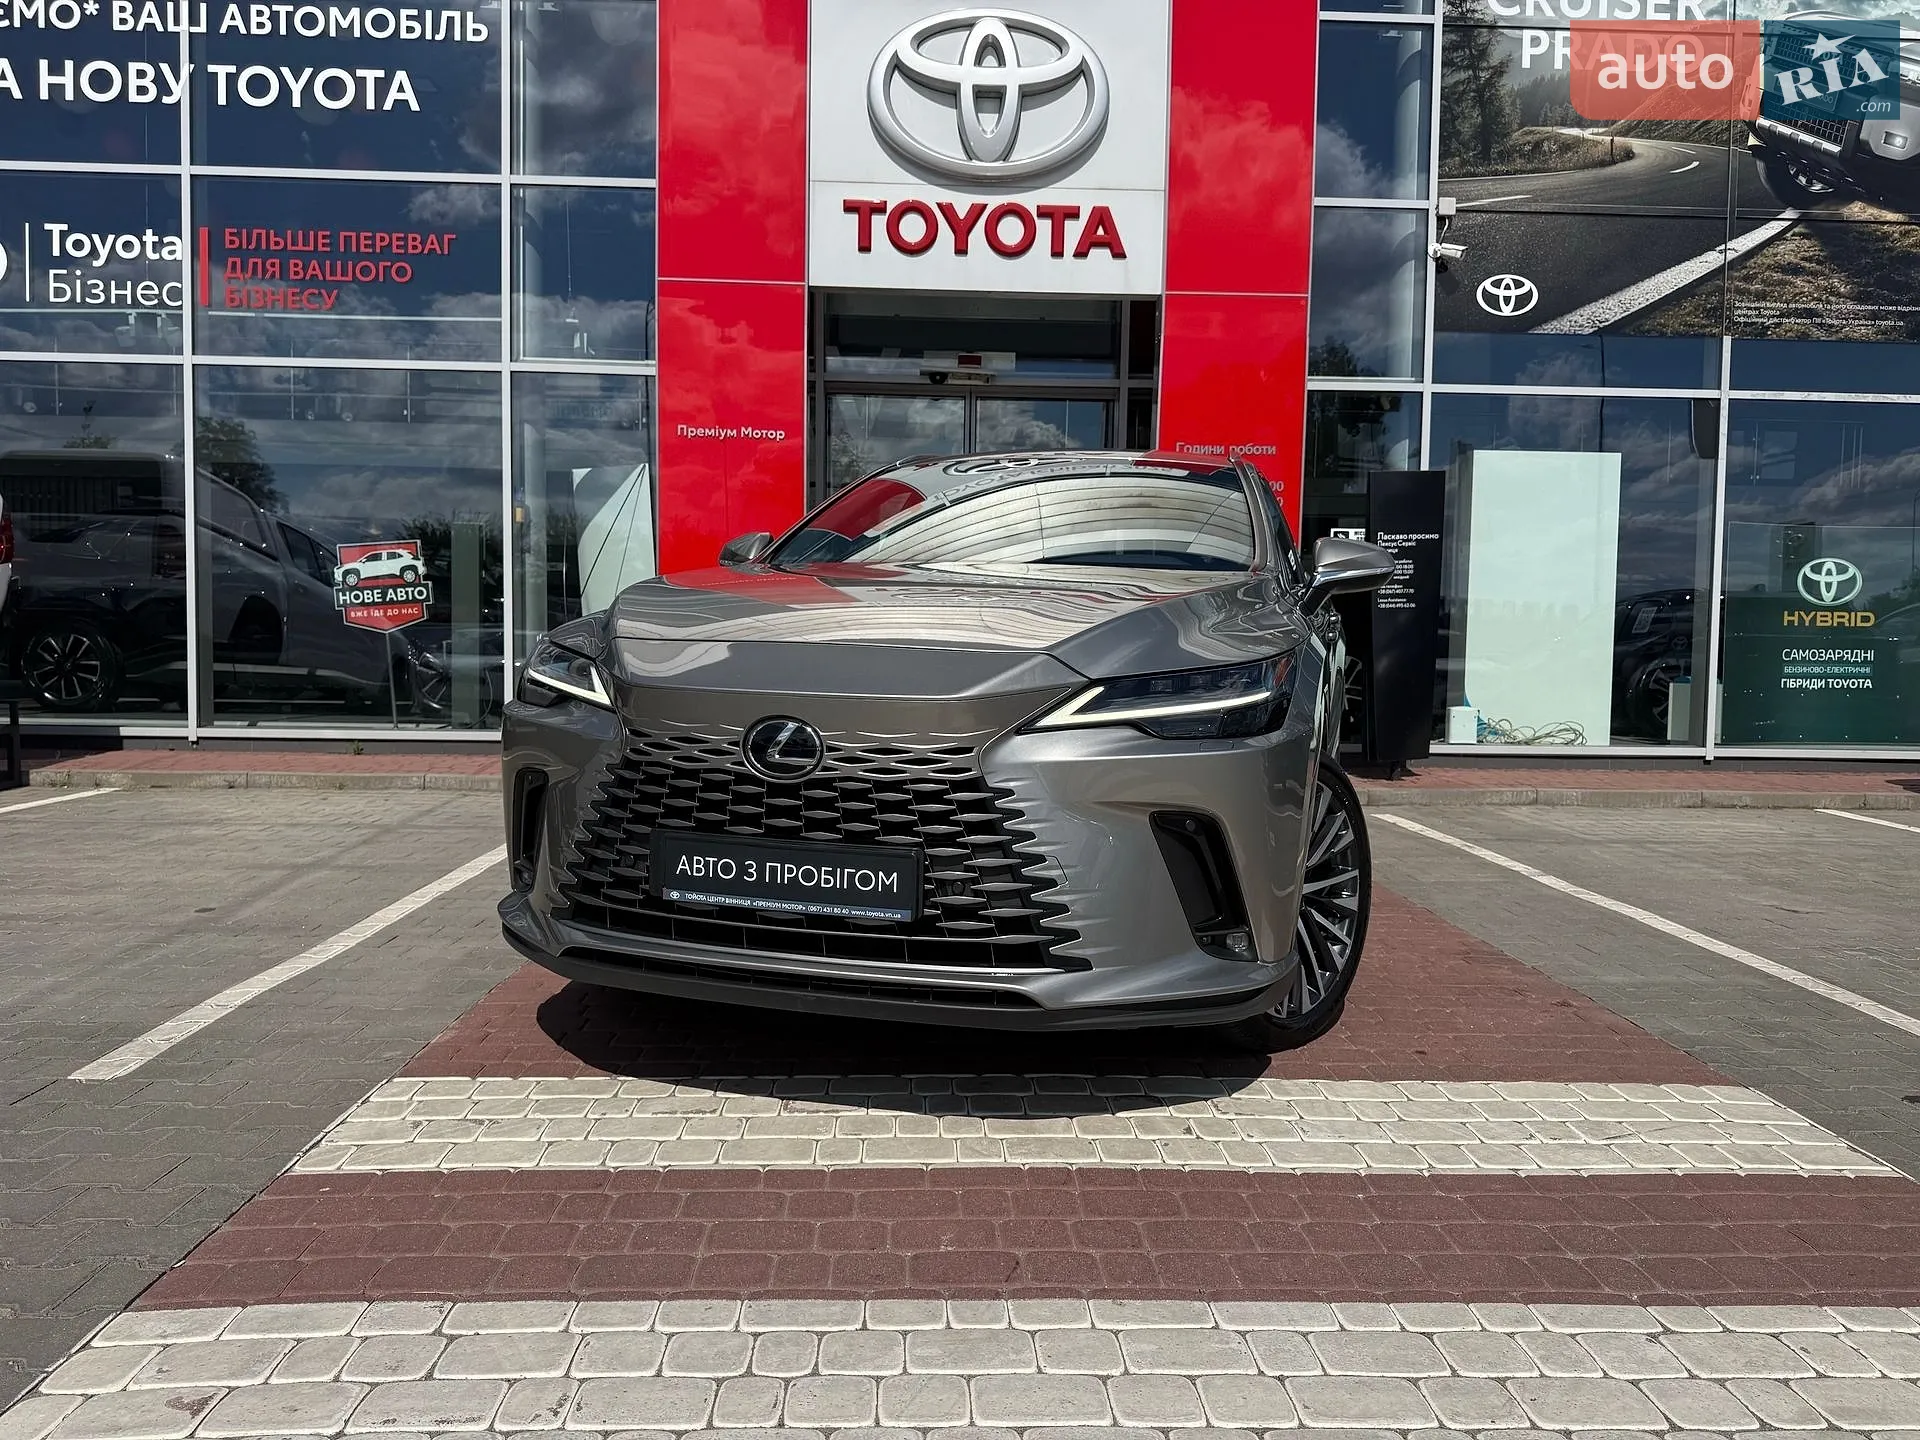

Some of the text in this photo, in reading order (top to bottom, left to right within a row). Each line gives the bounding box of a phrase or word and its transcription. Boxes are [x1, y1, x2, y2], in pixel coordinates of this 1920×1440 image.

[113, 0, 207, 32] ВАШ
[219, 4, 489, 42] АВТОМОБІЛЬ
[39, 58, 194, 104] НОВУ
[207, 64, 420, 111] TOYOTA
[843, 199, 1127, 259] TOYOTA
[44, 223, 183, 267] Toyota
[224, 228, 456, 255] БІЛЬШЕ ПЕРЕВАГ
[223, 257, 413, 283] ДЛЯ ВАШОГО
[49, 268, 183, 306] Бізнес
[224, 287, 339, 310] БІЗНЕСУ
[1875, 319, 1904, 327] toyota.ua
[677, 424, 785, 441] Преміум Мотор
[1175, 442, 1224, 454] Години
[1377, 531, 1439, 541] Ласкаво просимо
[339, 586, 427, 605] НОВЕ АВТО
[350, 610, 368, 618] ВЖЕ
[370, 609, 384, 617] ЇДЕ
[386, 608, 399, 616] ДО
[1783, 610, 1875, 627] HYBRID
[1782, 648, 1875, 662] САМОЗАРЯДНІ
[1784, 666, 1870, 674] БЕНЗИНОВО-ЕЛЕКТРИЧНІ
[1781, 678, 1873, 690] ГІБРИДИ TOYOTA
[676, 854, 898, 893] АВТО З ПРОБІГОМ
[685, 893, 707, 902] ТОЙОТА
[707, 896, 725, 904] ЦЕНТР
[725, 898, 751, 906] ВІННИЦЯ
[752, 899, 781, 909] «ПРЕМІУМ
[807, 904, 823, 912] (067)
[850, 909, 901, 918] www.toyota.vn.ua
